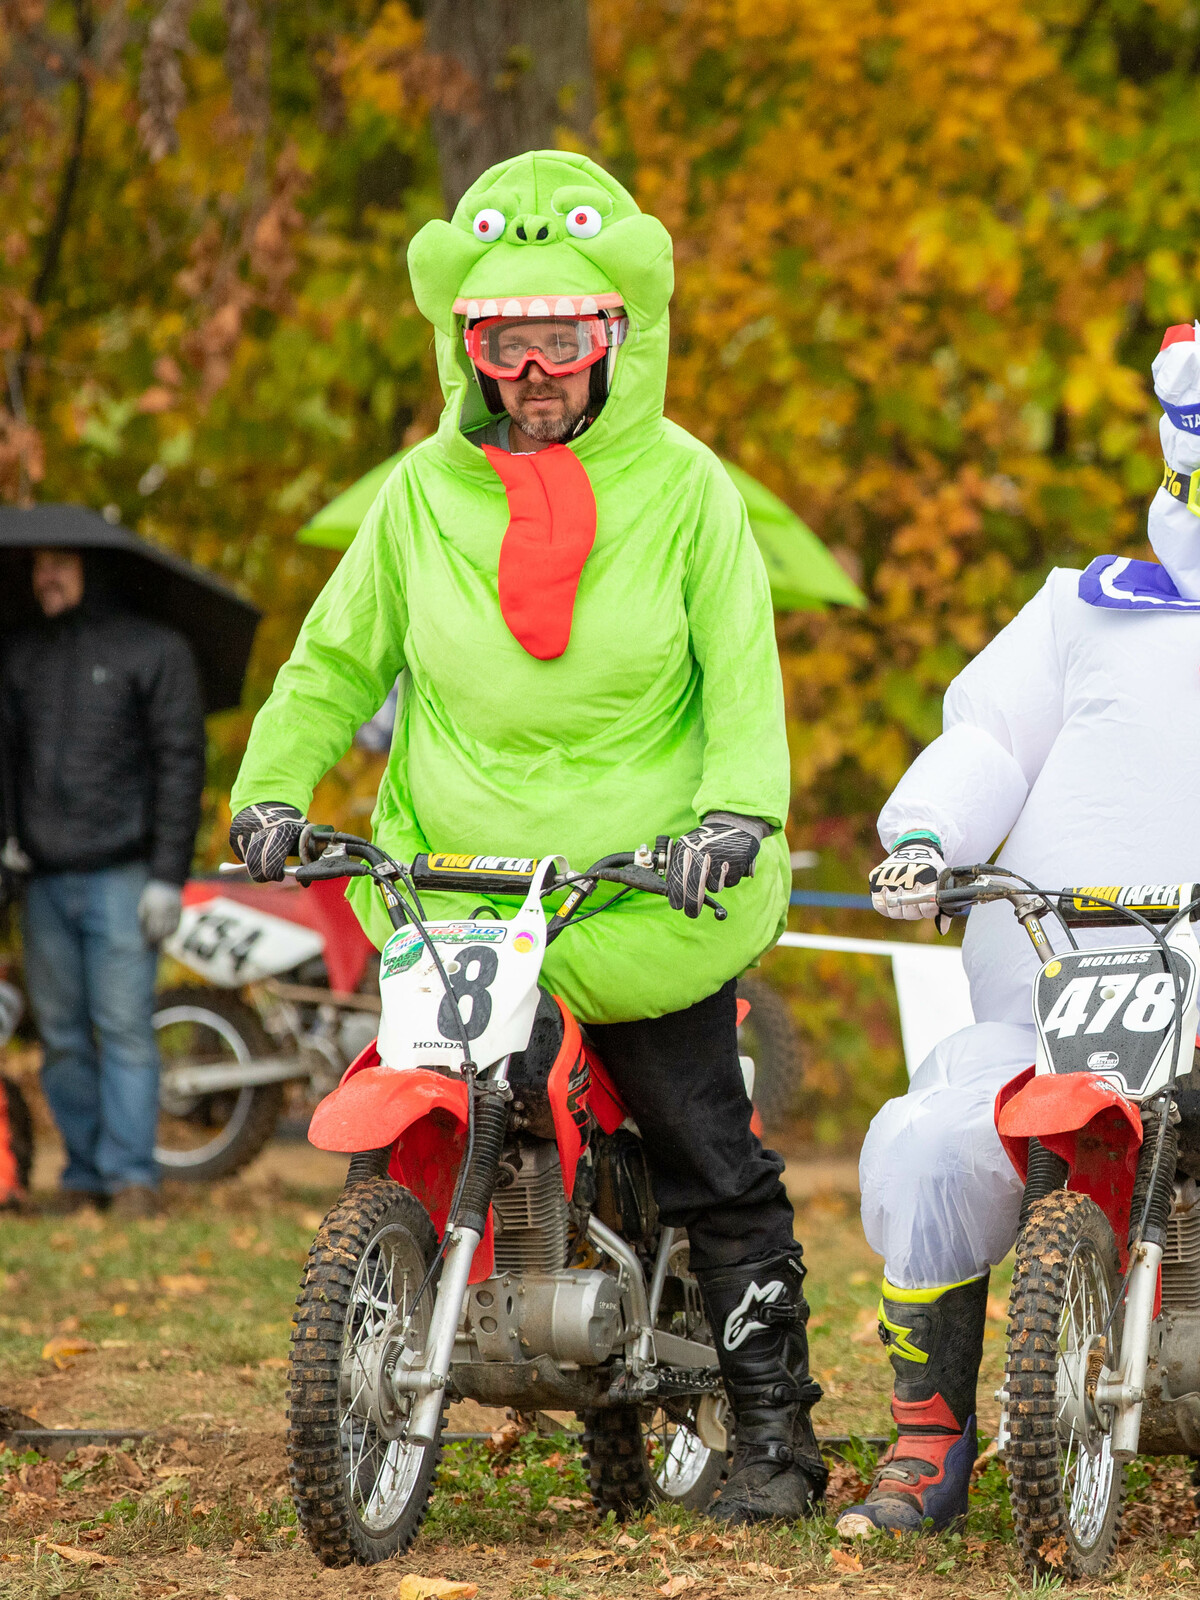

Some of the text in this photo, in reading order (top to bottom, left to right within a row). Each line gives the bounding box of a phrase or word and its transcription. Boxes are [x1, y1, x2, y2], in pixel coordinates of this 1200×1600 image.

[1078, 952, 1151, 968] HOLMES
[437, 945, 499, 1041] 8
[1043, 972, 1185, 1039] 478
[412, 1041, 465, 1050] HONDA
